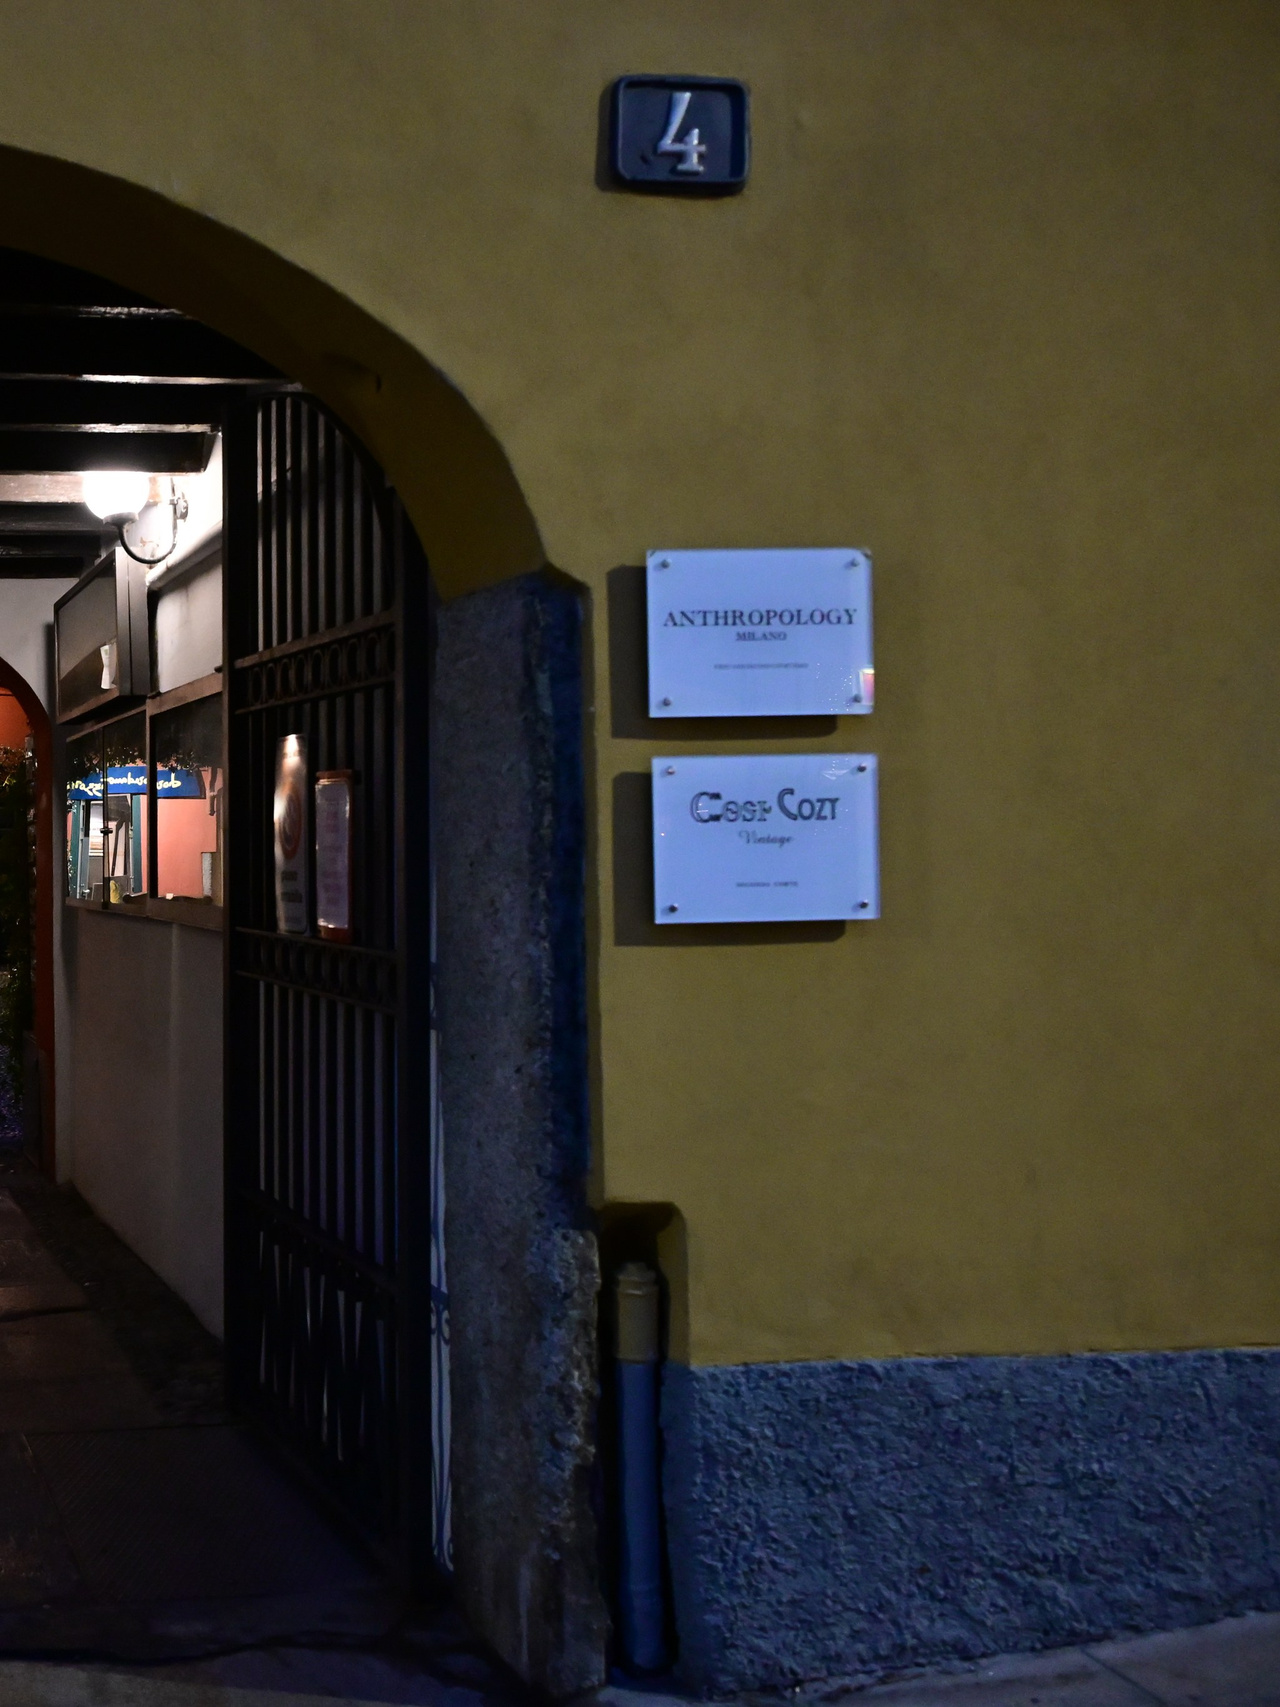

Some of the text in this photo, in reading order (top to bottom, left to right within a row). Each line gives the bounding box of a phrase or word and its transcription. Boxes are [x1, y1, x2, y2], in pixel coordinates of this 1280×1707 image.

[657, 92, 706, 172] 4
[663, 608, 857, 627] ANTHROPOLOGY
[735, 631, 787, 641] MILANO
